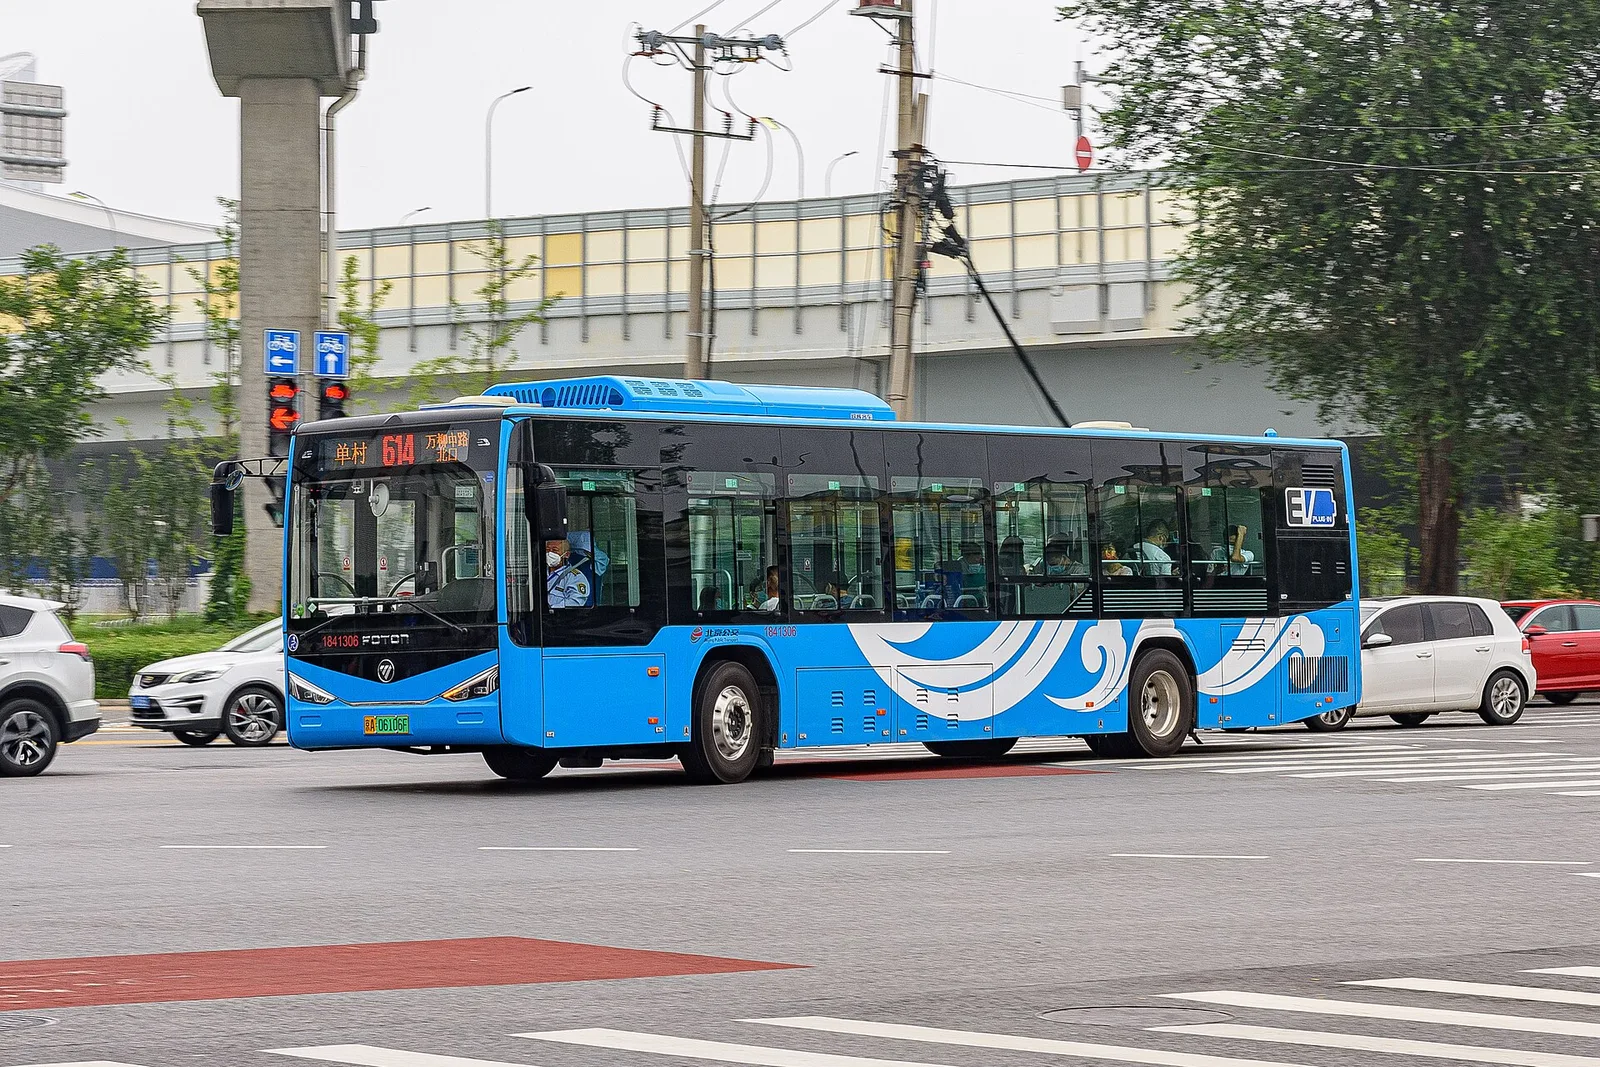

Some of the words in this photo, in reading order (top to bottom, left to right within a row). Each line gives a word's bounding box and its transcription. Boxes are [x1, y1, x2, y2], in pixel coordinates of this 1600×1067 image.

[425, 431, 469, 449] 万柳中路
[335, 441, 367, 466] 单村
[382, 434, 415, 467] 614
[436, 448, 459, 463] 北口
[705, 628, 739, 637] 北京公交
[764, 625, 797, 637] 1841306
[322, 635, 359, 648] 1841306
[362, 633, 410, 645] FOTON
